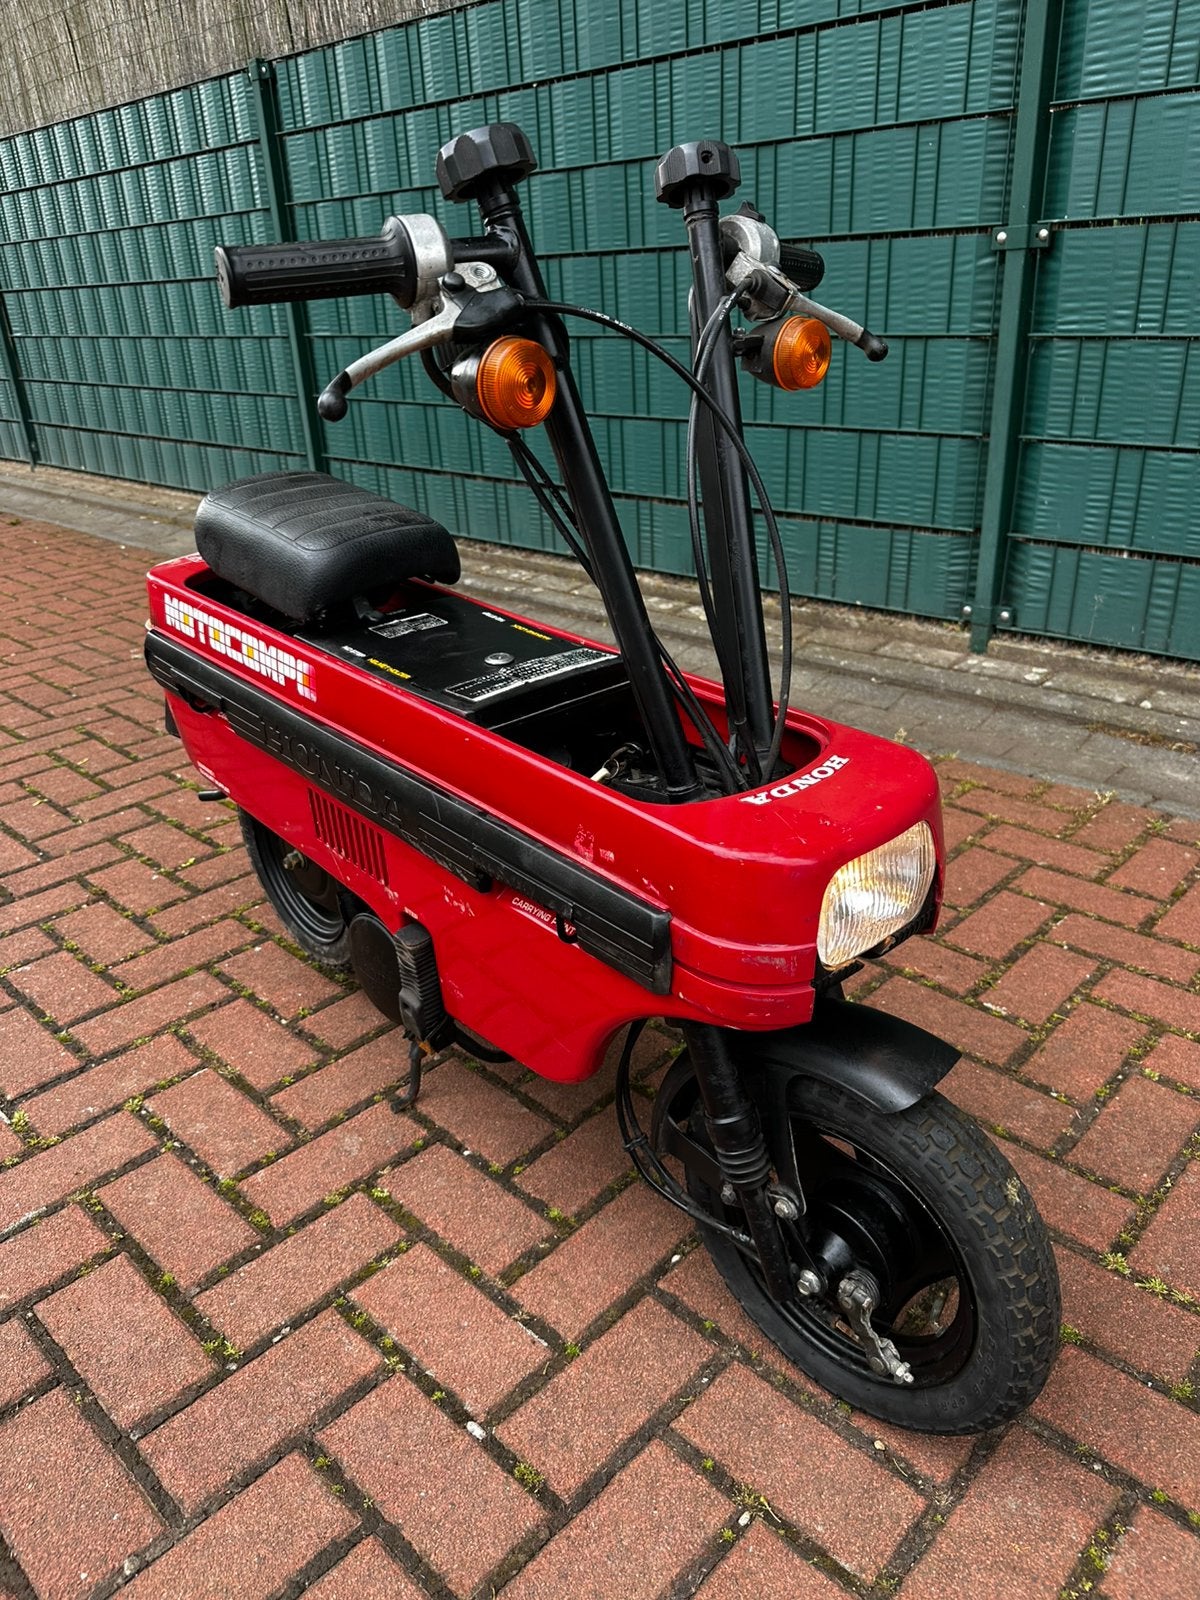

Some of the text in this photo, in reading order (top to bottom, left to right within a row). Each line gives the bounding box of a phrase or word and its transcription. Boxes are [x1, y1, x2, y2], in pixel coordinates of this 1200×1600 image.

[164, 593, 317, 702] MOTOCOMPO
[259, 717, 420, 840] HONDA
[739, 754, 850, 805] HONDA
[511, 897, 551, 922] CARRYING
